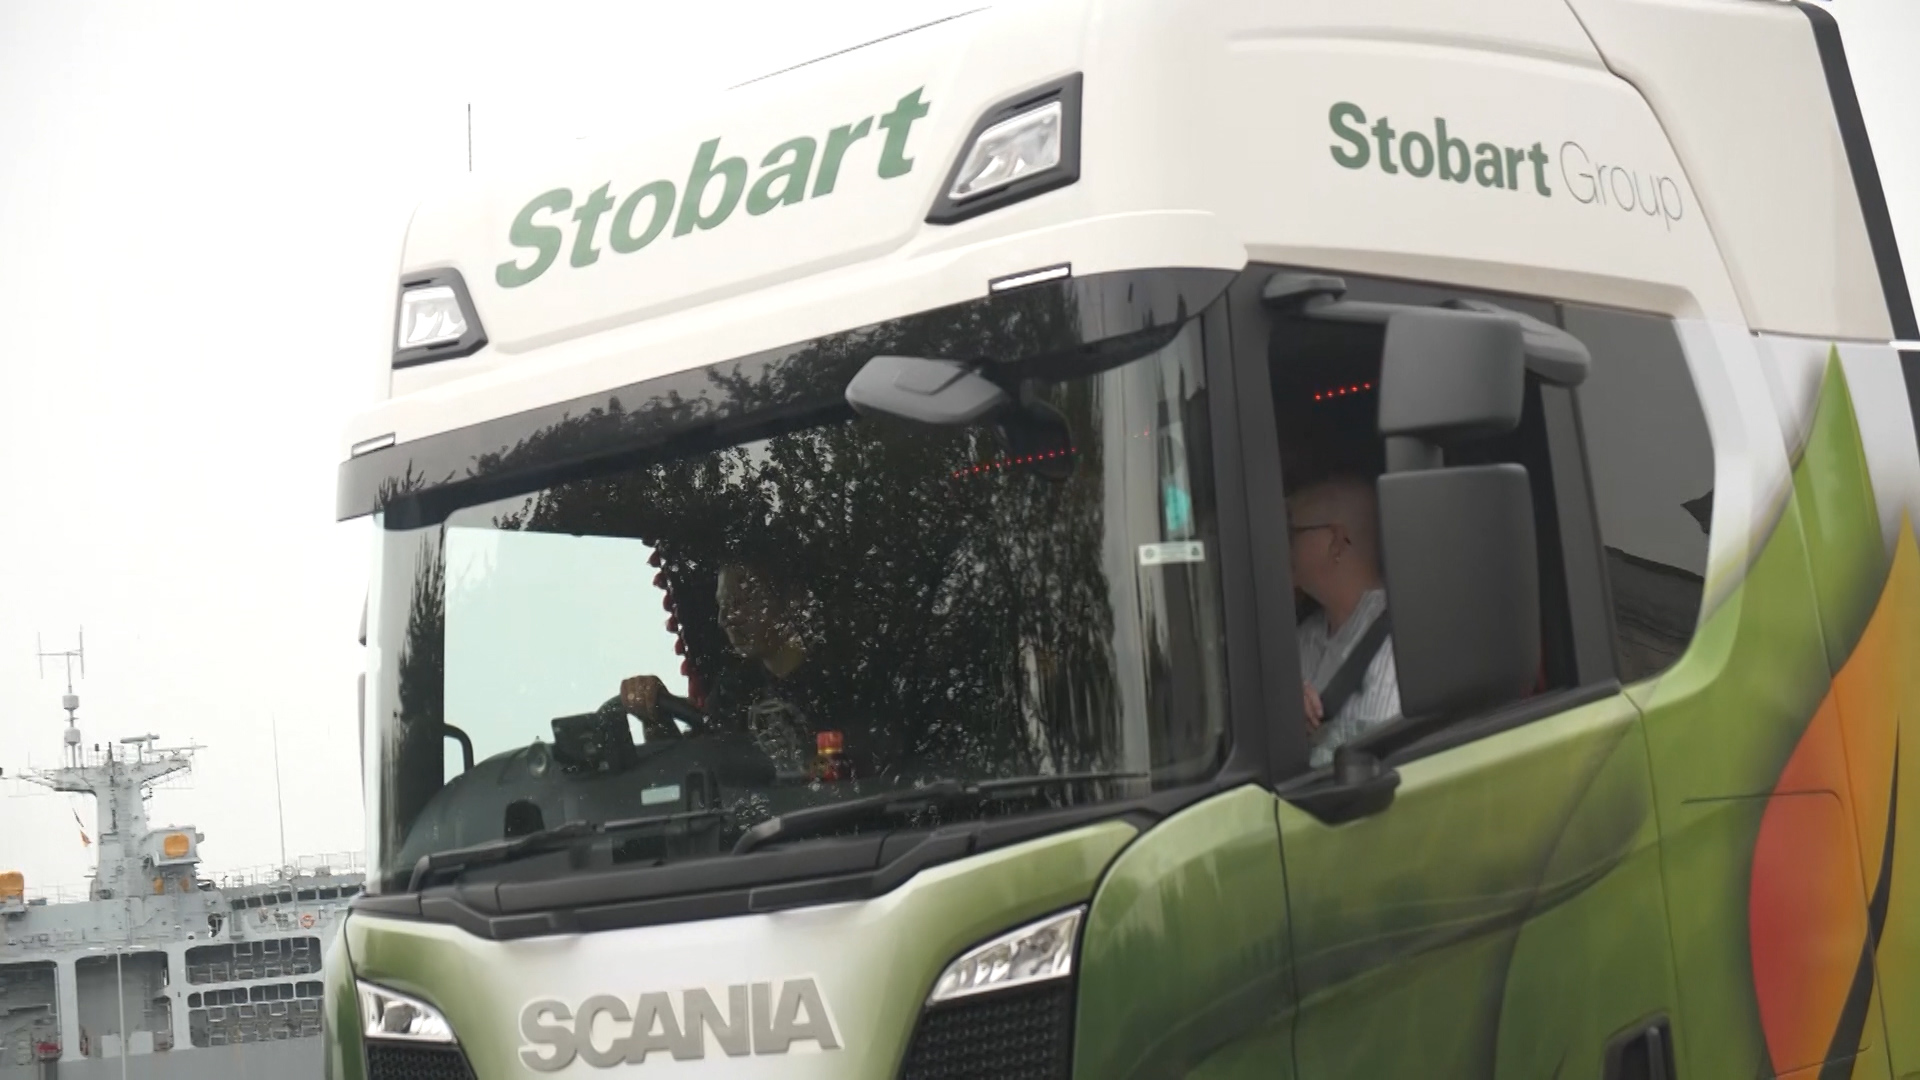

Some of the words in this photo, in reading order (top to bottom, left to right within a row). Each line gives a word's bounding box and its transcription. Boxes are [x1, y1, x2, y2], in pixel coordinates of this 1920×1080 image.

[495, 85, 931, 288] Stobart
[1328, 101, 1552, 198] Stobart
[1559, 141, 1684, 232] Group
[518, 978, 844, 1072] SCANIA
